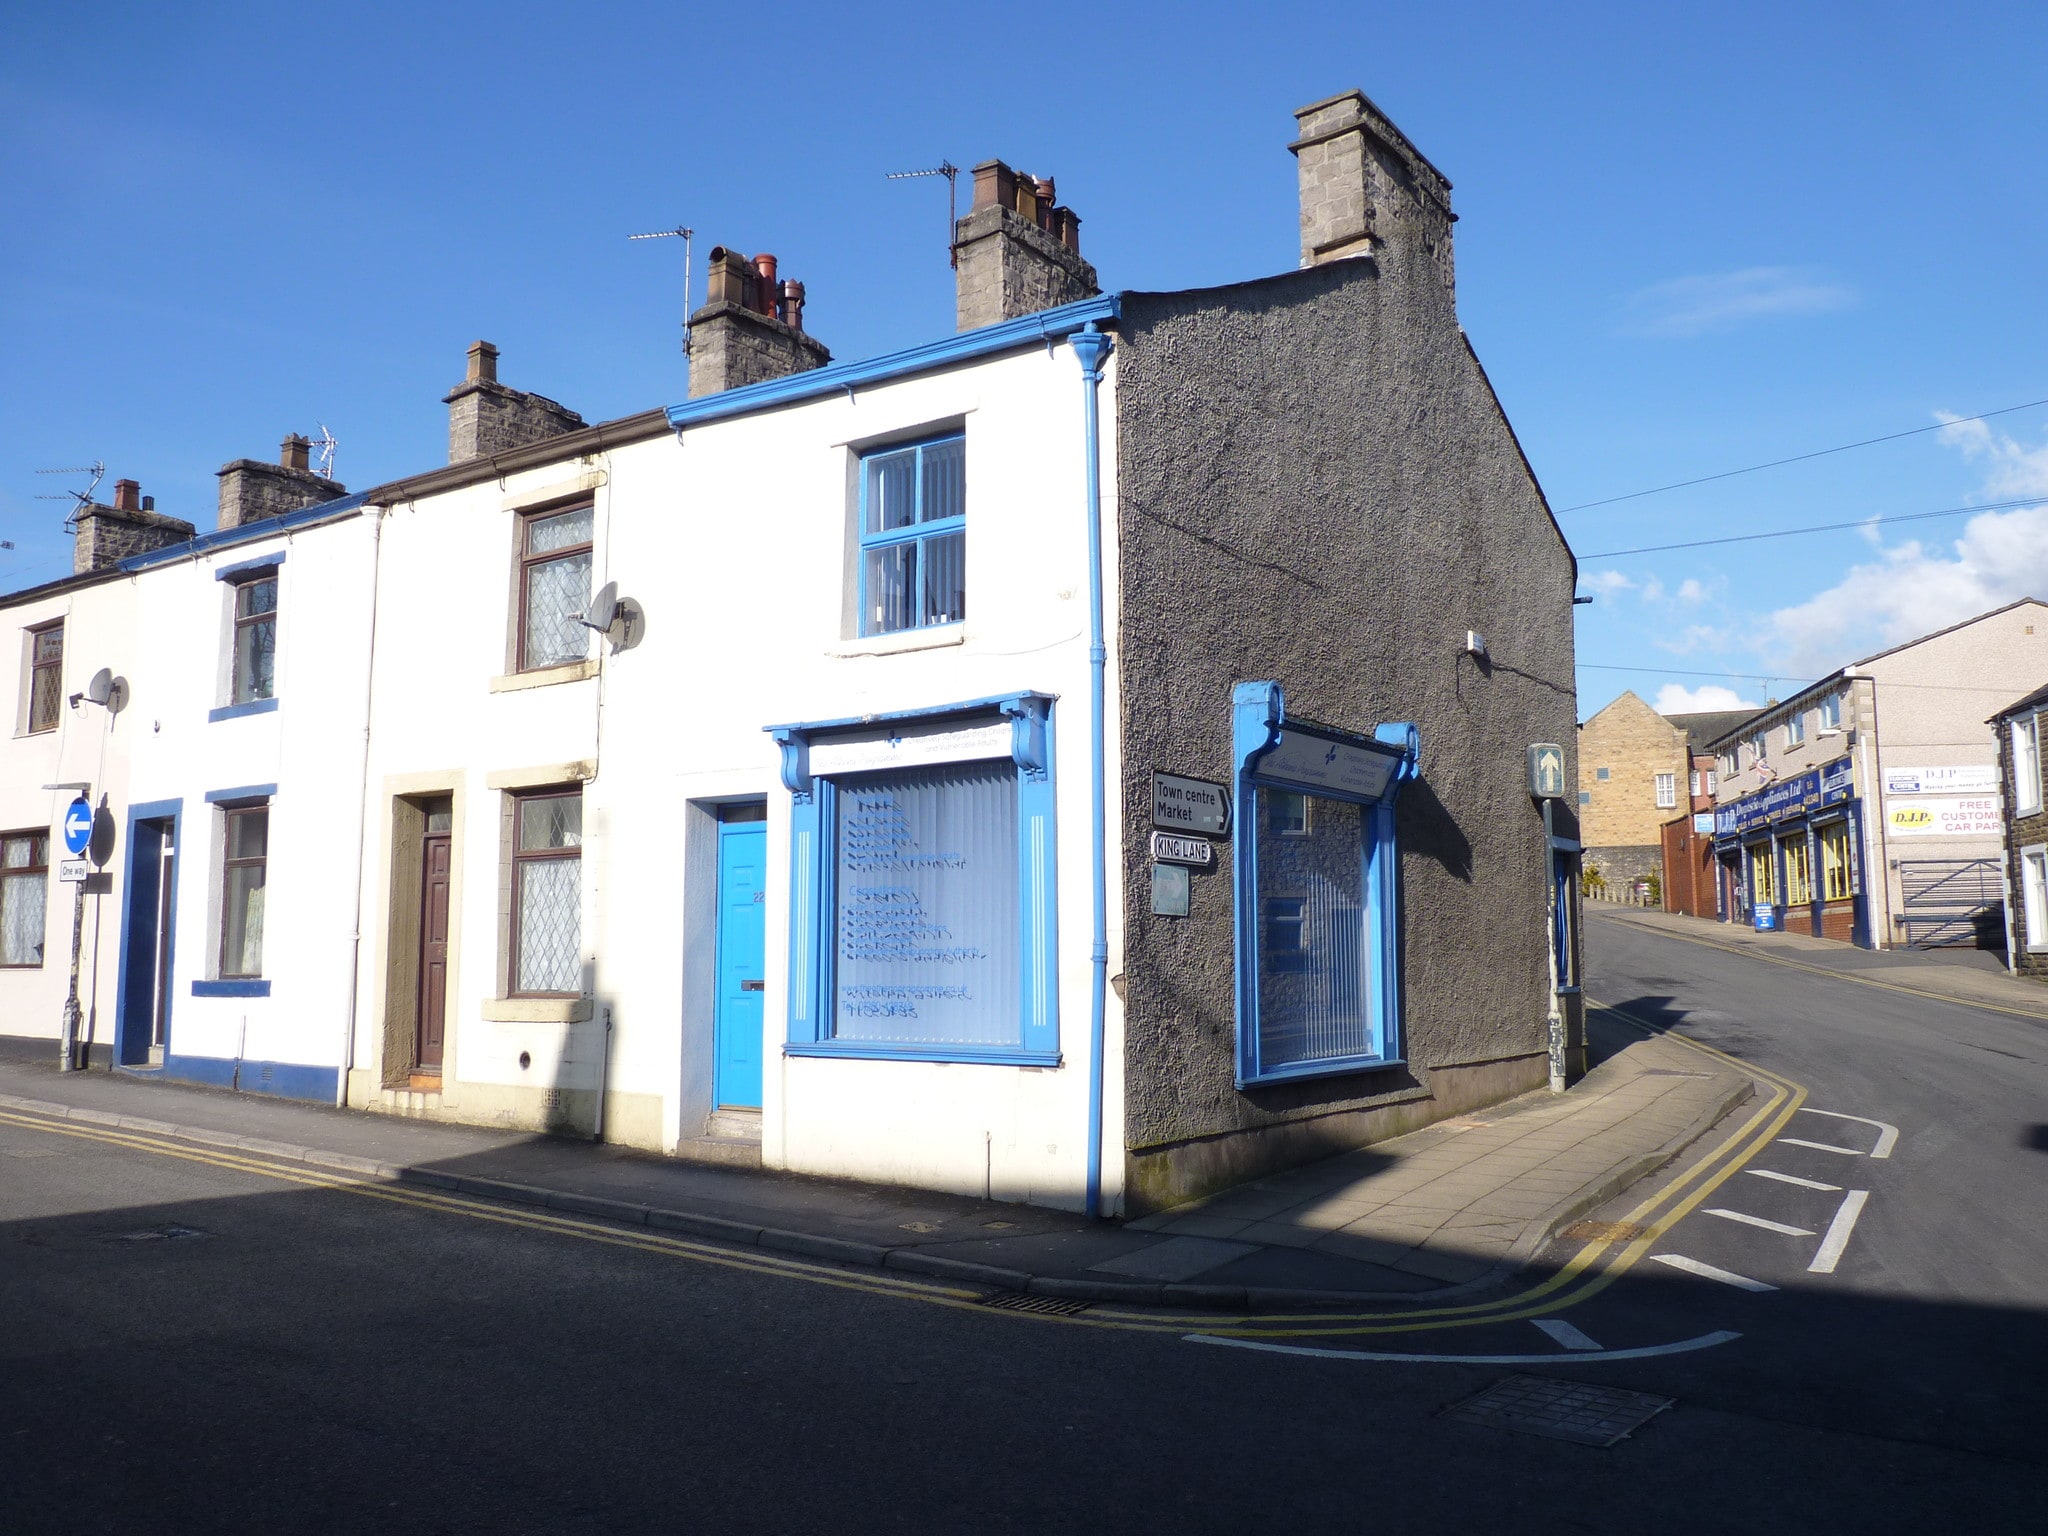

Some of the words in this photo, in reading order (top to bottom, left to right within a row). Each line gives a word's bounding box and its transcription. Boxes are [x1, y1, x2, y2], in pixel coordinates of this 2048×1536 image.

[988, 726, 1013, 736] Childre
[1157, 781, 1183, 800] Town
[1185, 788, 1215, 806] centre
[1789, 779, 1801, 798] Ltd
[1959, 800, 1992, 810] FREE
[1157, 801, 1193, 821] Market
[1941, 811, 1998, 821] CUSTOME
[1895, 812, 1931, 823] D.J.P.
[1945, 822, 1971, 832] CAR
[1975, 822, 2000, 831] PAR
[1157, 838, 1179, 856] KING
[1181, 841, 1207, 860] LANE
[62, 866, 73, 876] One
[74, 867, 85, 877] way
[753, 891, 765, 903] 22
